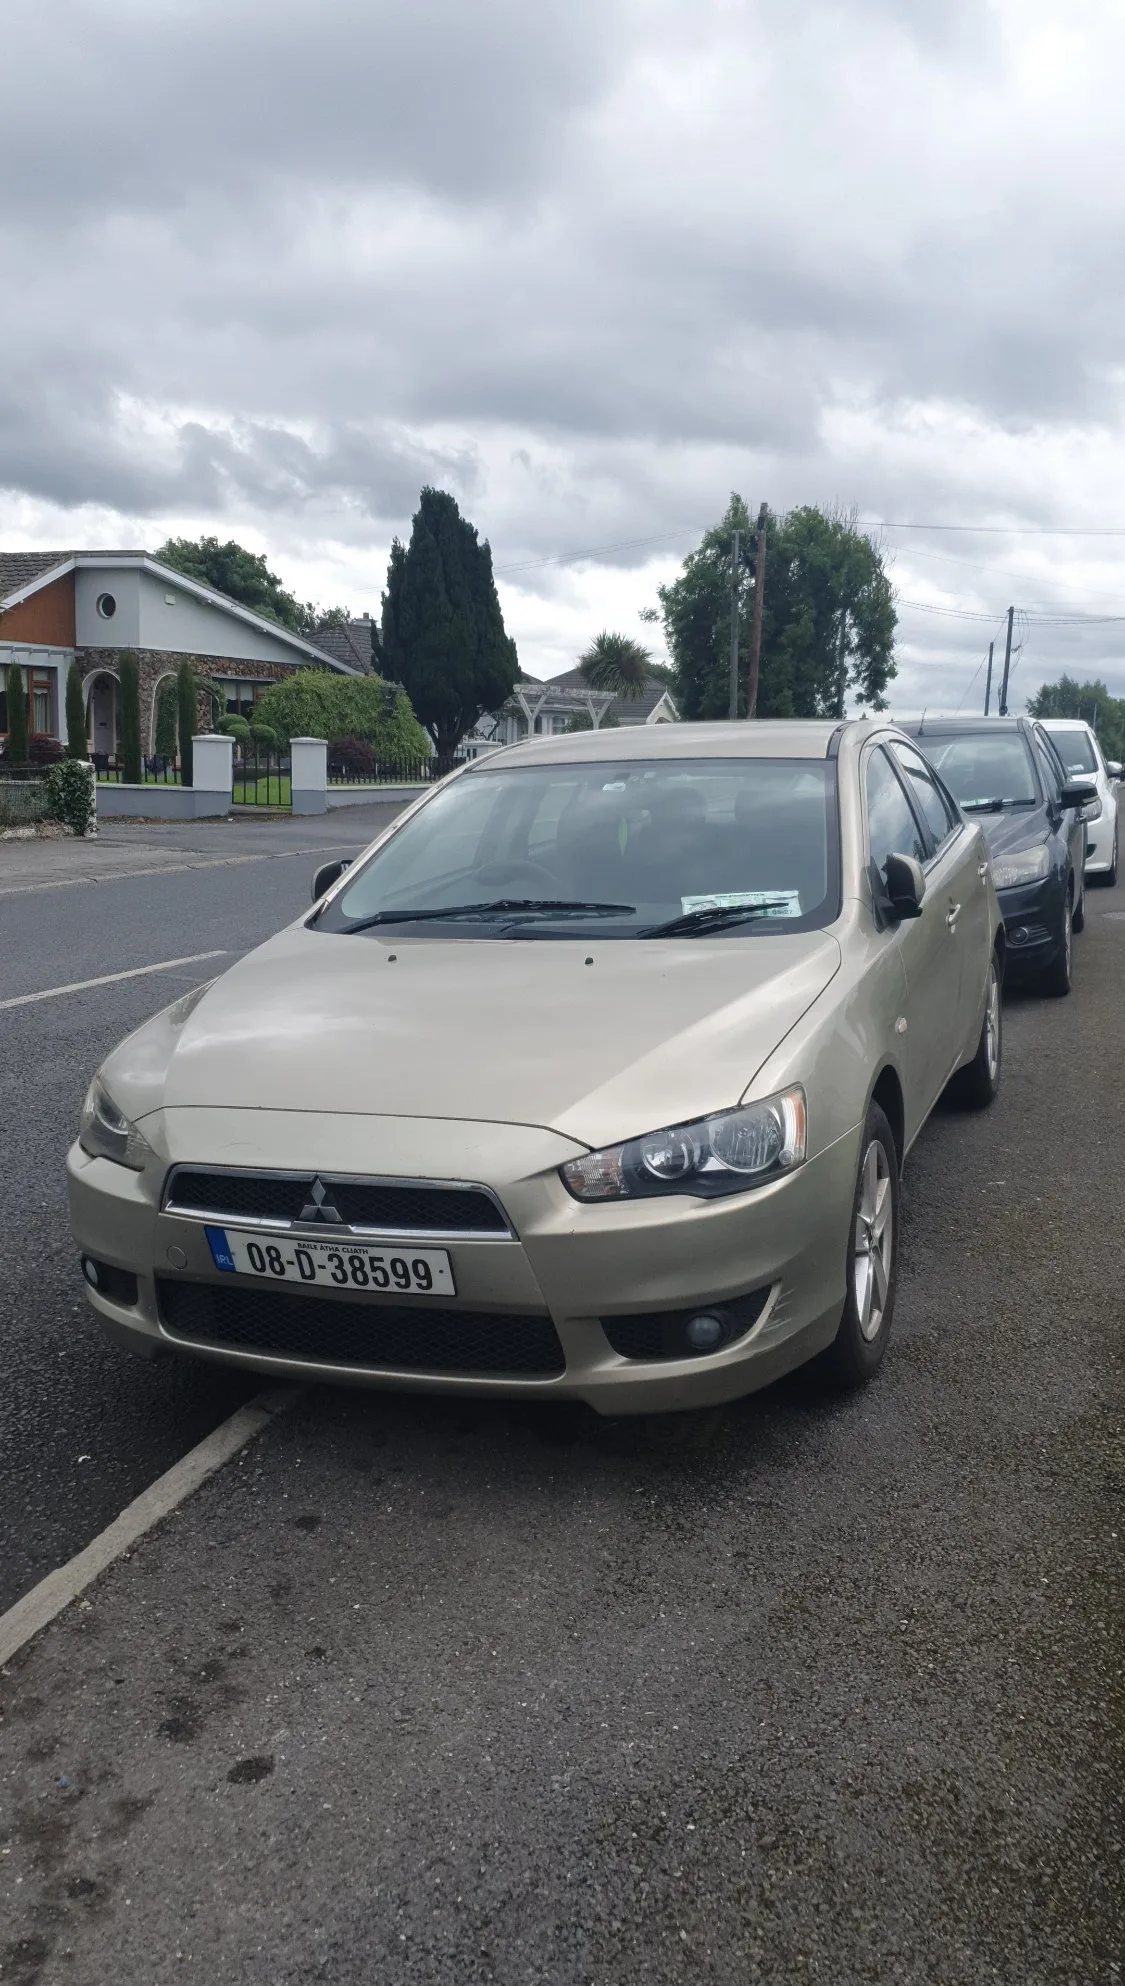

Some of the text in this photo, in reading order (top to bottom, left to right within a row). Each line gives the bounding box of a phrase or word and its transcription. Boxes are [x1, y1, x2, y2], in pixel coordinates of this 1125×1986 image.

[297, 1243, 318, 1251] BAILE
[342, 1247, 369, 1255] CLIATH
[216, 1254, 234, 1266] IRL
[247, 1242, 433, 1291] 08-D-38599
